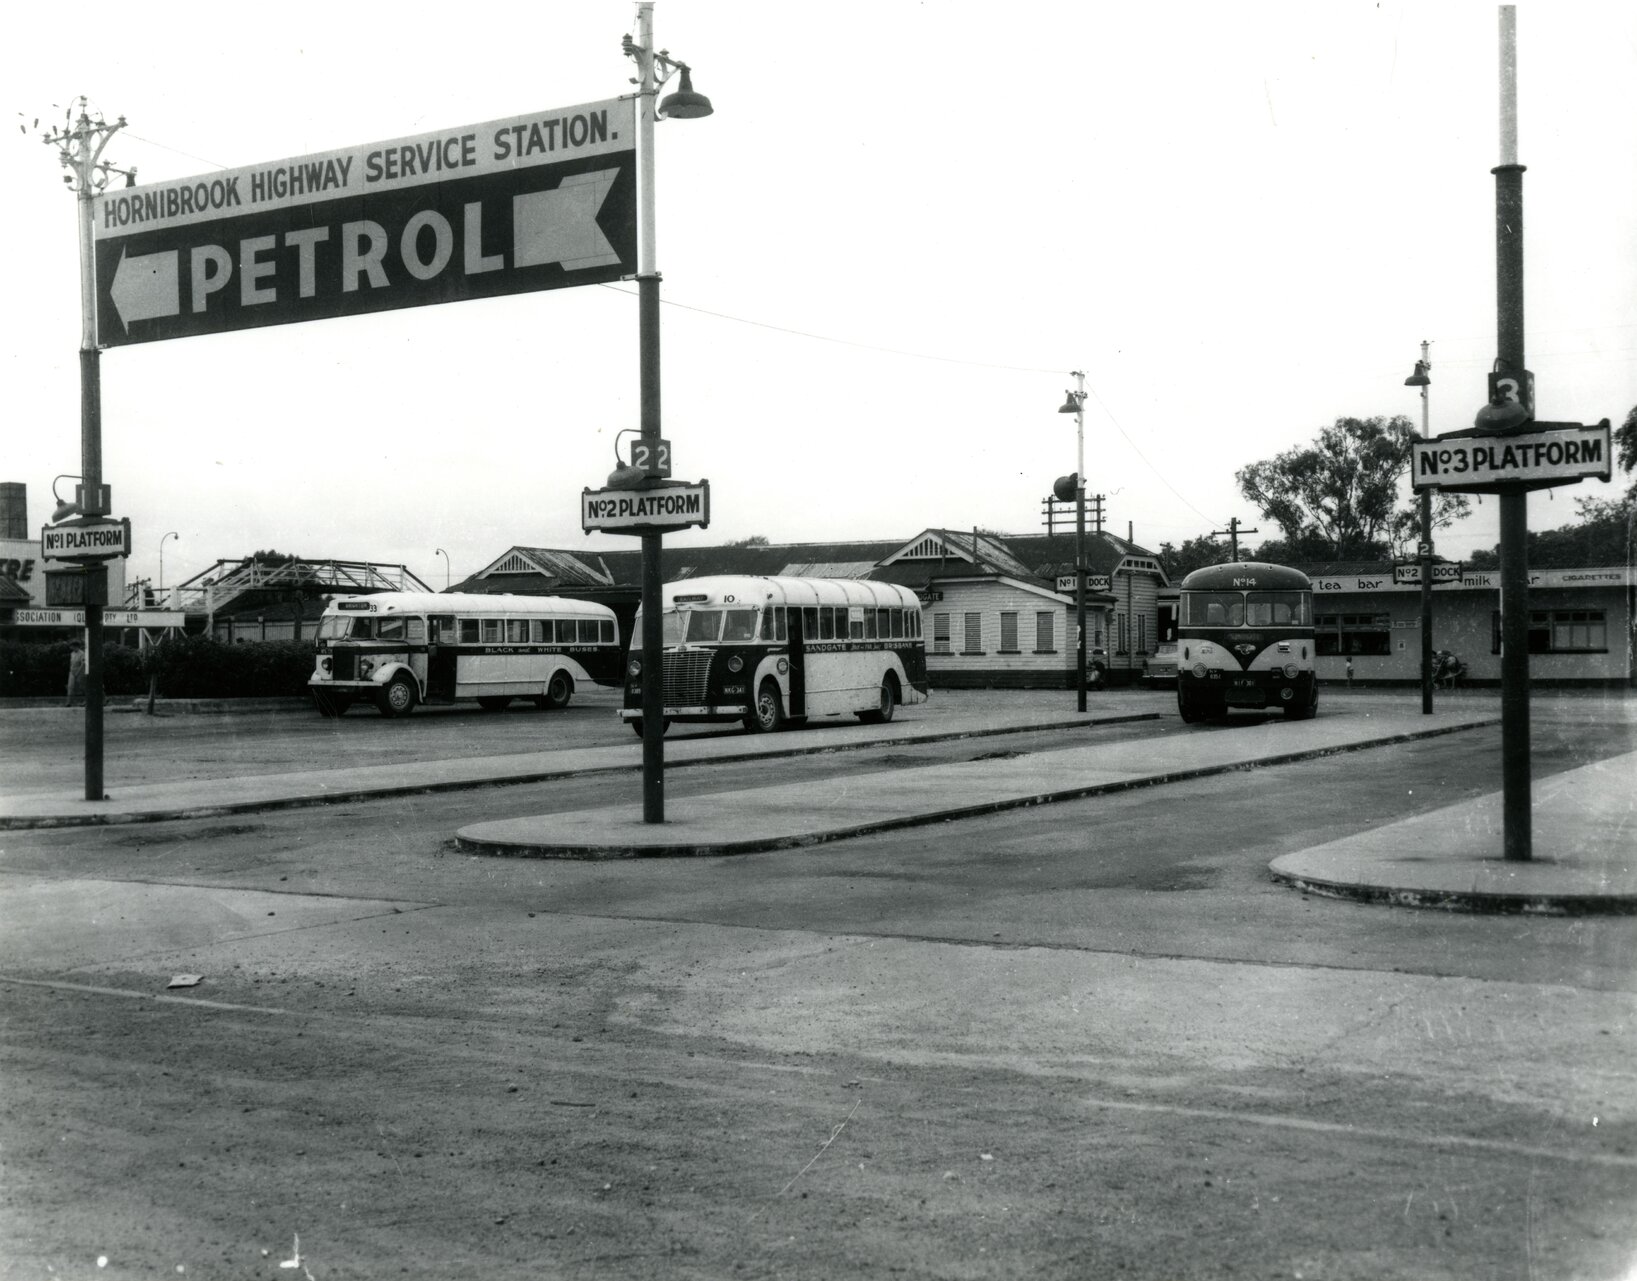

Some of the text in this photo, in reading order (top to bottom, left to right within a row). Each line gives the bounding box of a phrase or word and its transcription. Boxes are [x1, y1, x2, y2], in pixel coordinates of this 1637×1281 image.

[103, 109, 619, 229] HORNIBROOK HIGHWAY SERVICE STATION.
[191, 201, 504, 313] PETROL
[635, 446, 650, 470] 2
[657, 445, 668, 469] 2
[1472, 438, 1603, 472] PLATFORM
[619, 494, 700, 517] PLATFORM
[66, 530, 122, 548] PLATFORM
[1433, 567, 1460, 577] DOCK
[1562, 574, 1622, 582] CIGARETTES
[1088, 577, 1110, 587] DOCK
[1319, 575, 1491, 590] tea bar milk
[723, 594, 736, 603] 10
[369, 604, 378, 613] 33
[104, 612, 117, 623] PTY
[805, 643, 847, 652] SANDGATE
